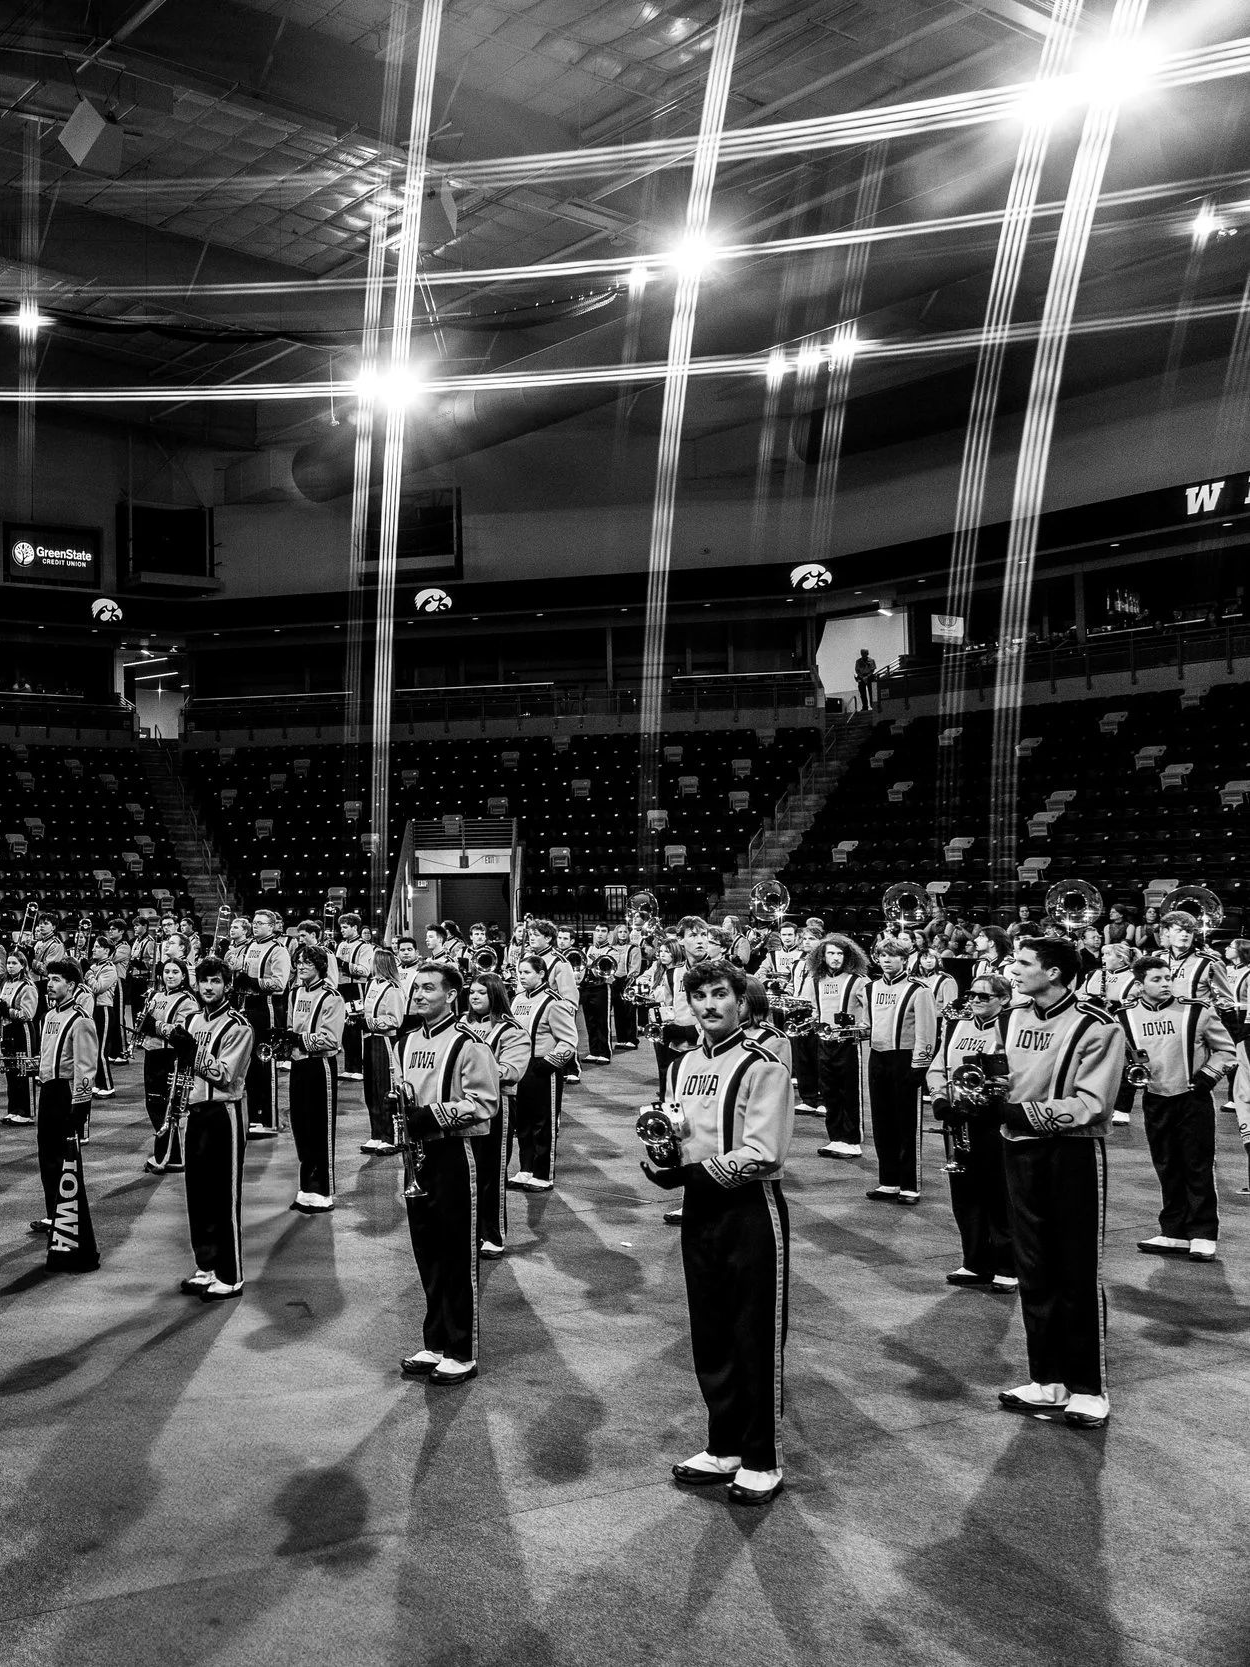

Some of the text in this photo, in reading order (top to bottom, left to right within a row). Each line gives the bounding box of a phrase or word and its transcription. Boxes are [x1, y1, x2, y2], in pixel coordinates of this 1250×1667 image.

[36, 546, 92, 561] GreenState
[42, 558, 87, 568] CREDIT UNION
[876, 992, 897, 1005] IOWA
[1142, 1020, 1176, 1037] IOWA
[955, 1037, 986, 1052] IOWA
[408, 1051, 436, 1069] IOWA
[681, 1074, 720, 1096] IOWA
[51, 1158, 79, 1252] IOWA
